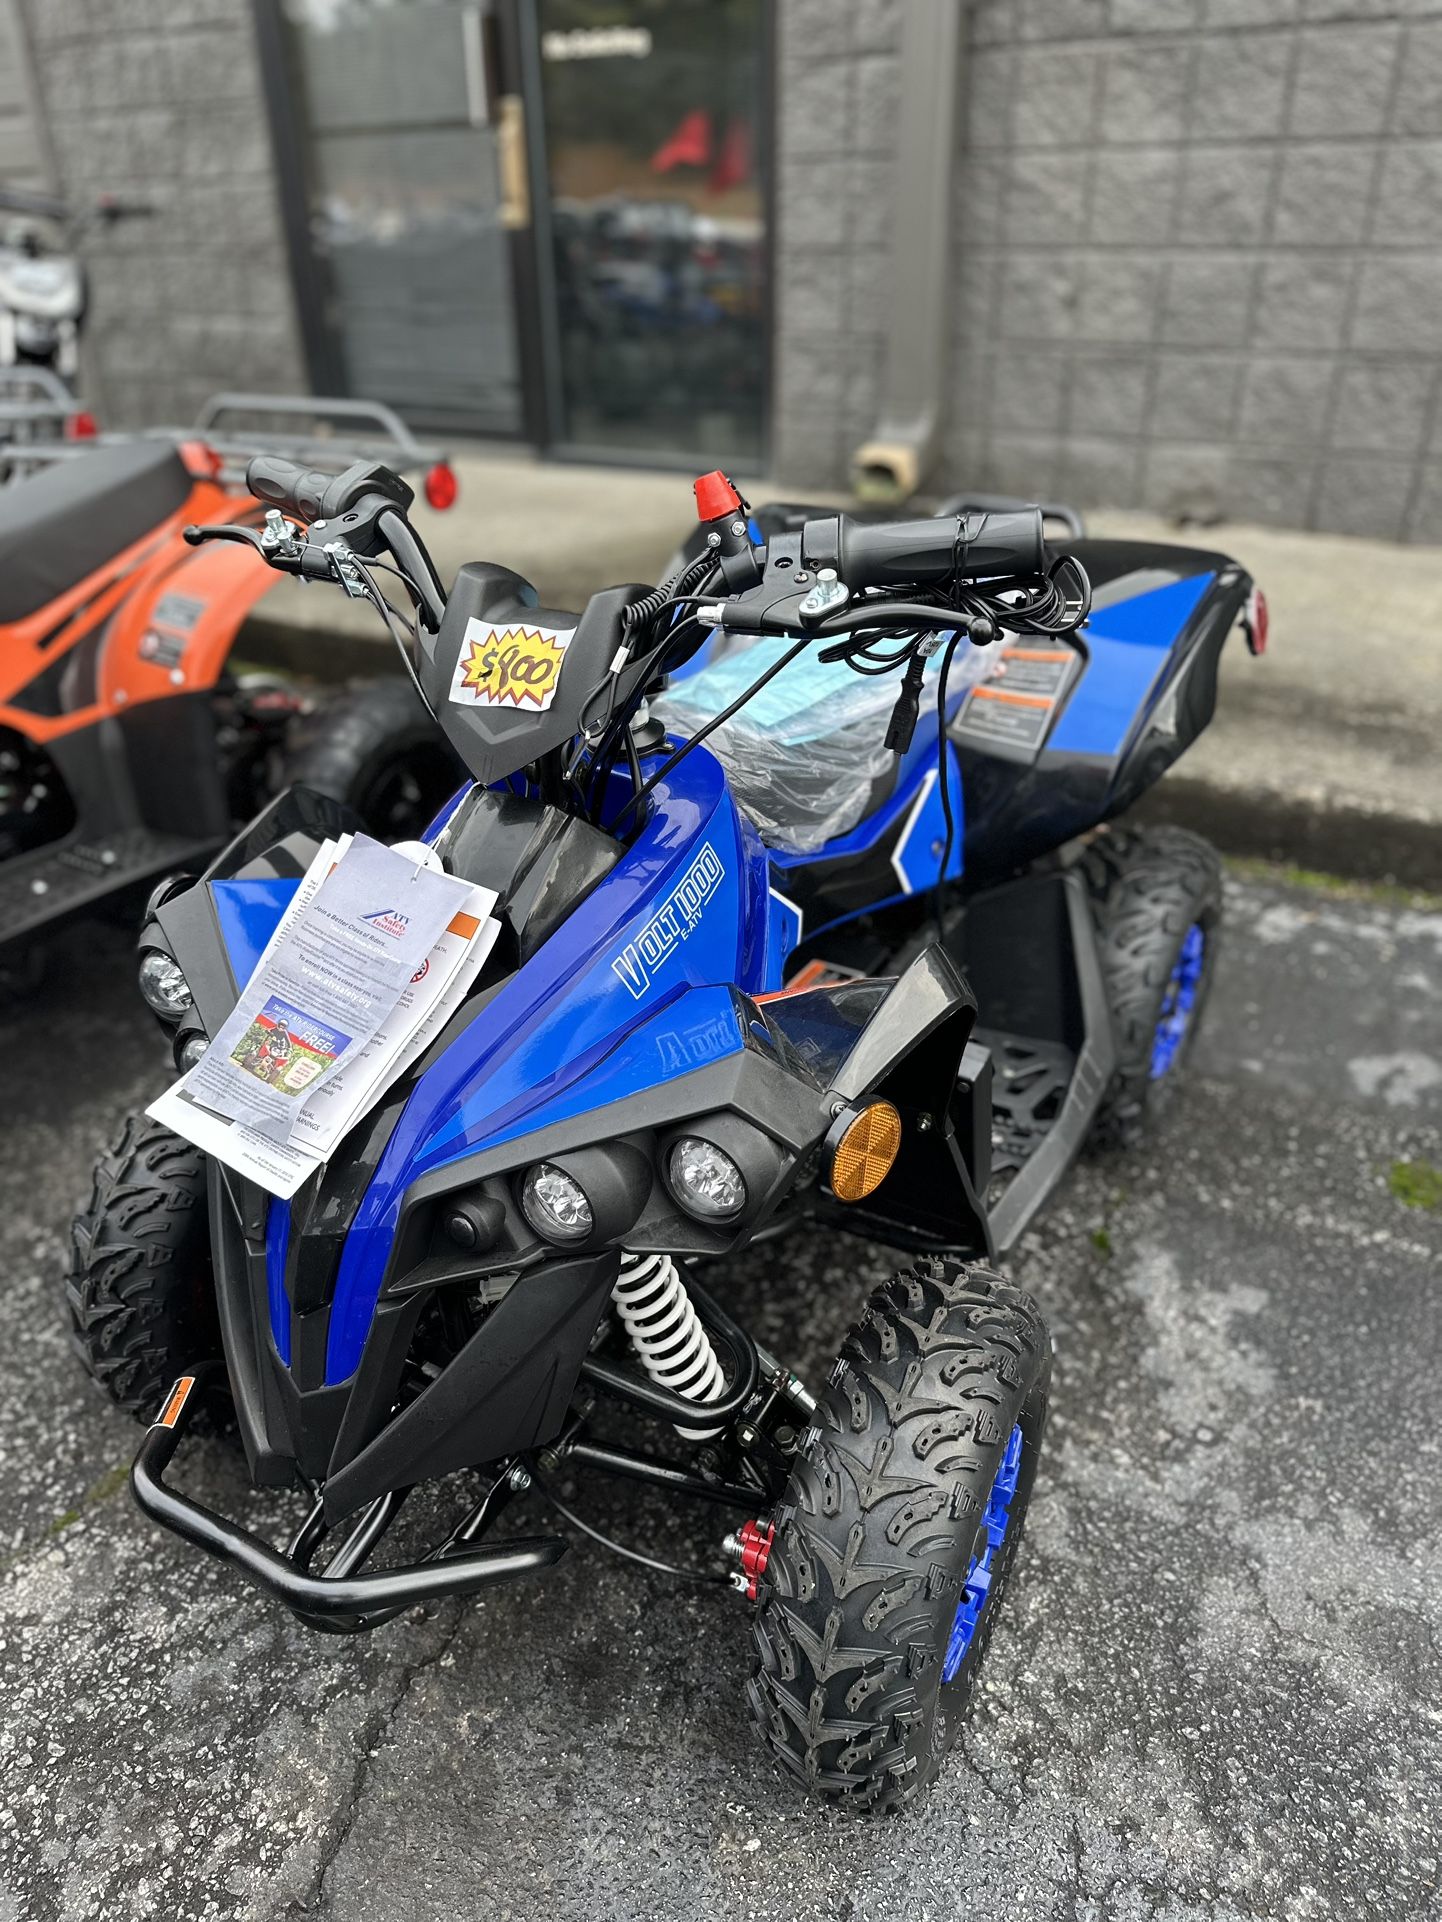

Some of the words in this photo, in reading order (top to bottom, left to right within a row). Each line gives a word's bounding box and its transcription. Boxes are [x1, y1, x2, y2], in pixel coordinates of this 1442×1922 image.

[313, 905, 328, 916] Join
[331, 914, 350, 927] Better
[348, 924, 363, 935] Class
[383, 916, 406, 931] Safety
[391, 912, 411, 925] ATV
[611, 904, 681, 1000] VOLT
[673, 845, 722, 922] 1000
[680, 906, 703, 941] E-ATV
[298, 953, 306, 961] To
[305, 957, 320, 969] enroll
[320, 966, 334, 976] NOW
[341, 977, 353, 988] class
[352, 984, 363, 993] near
[301, 965, 372, 1009] www.atvsafety.org
[298, 1031, 336, 1054] FREE!
